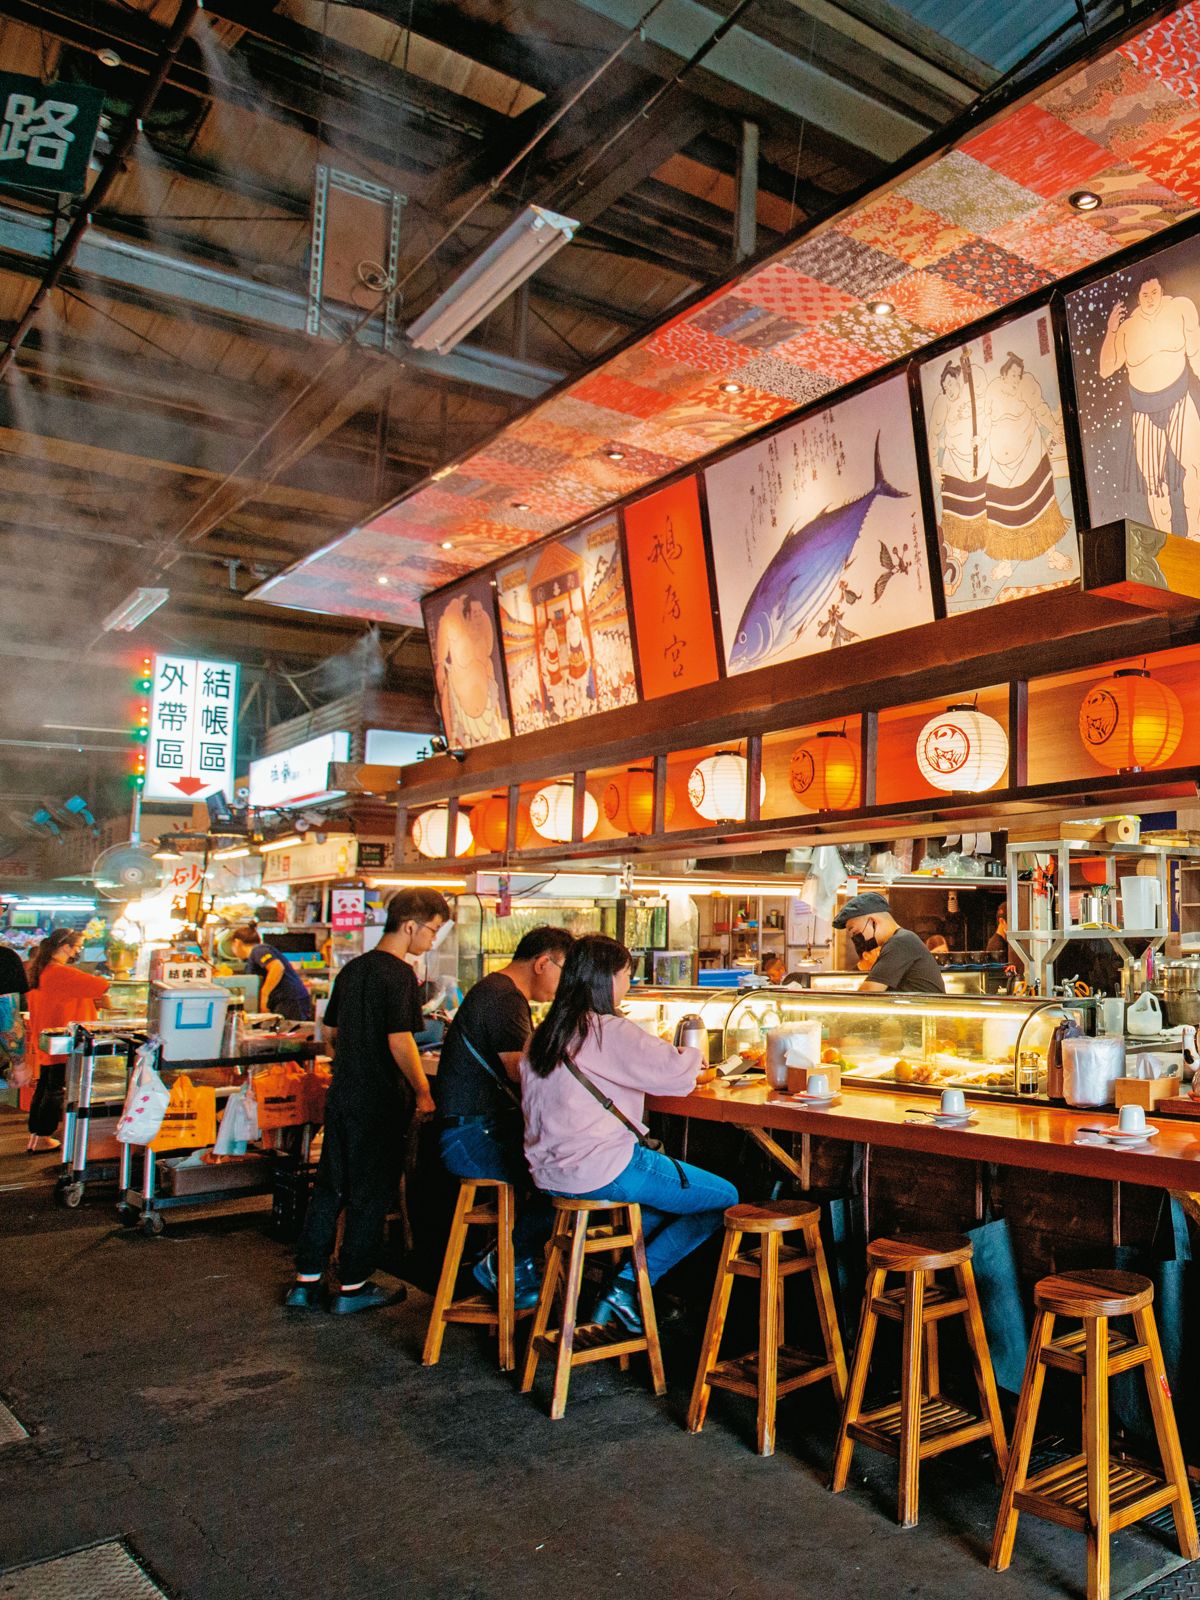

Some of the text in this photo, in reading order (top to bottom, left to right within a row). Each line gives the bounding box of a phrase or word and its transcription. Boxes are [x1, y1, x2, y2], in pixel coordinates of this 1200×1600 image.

[0, 93, 79, 170] 路
[156, 663, 188, 769] 外帶區
[200, 668, 231, 772] 結帳區
